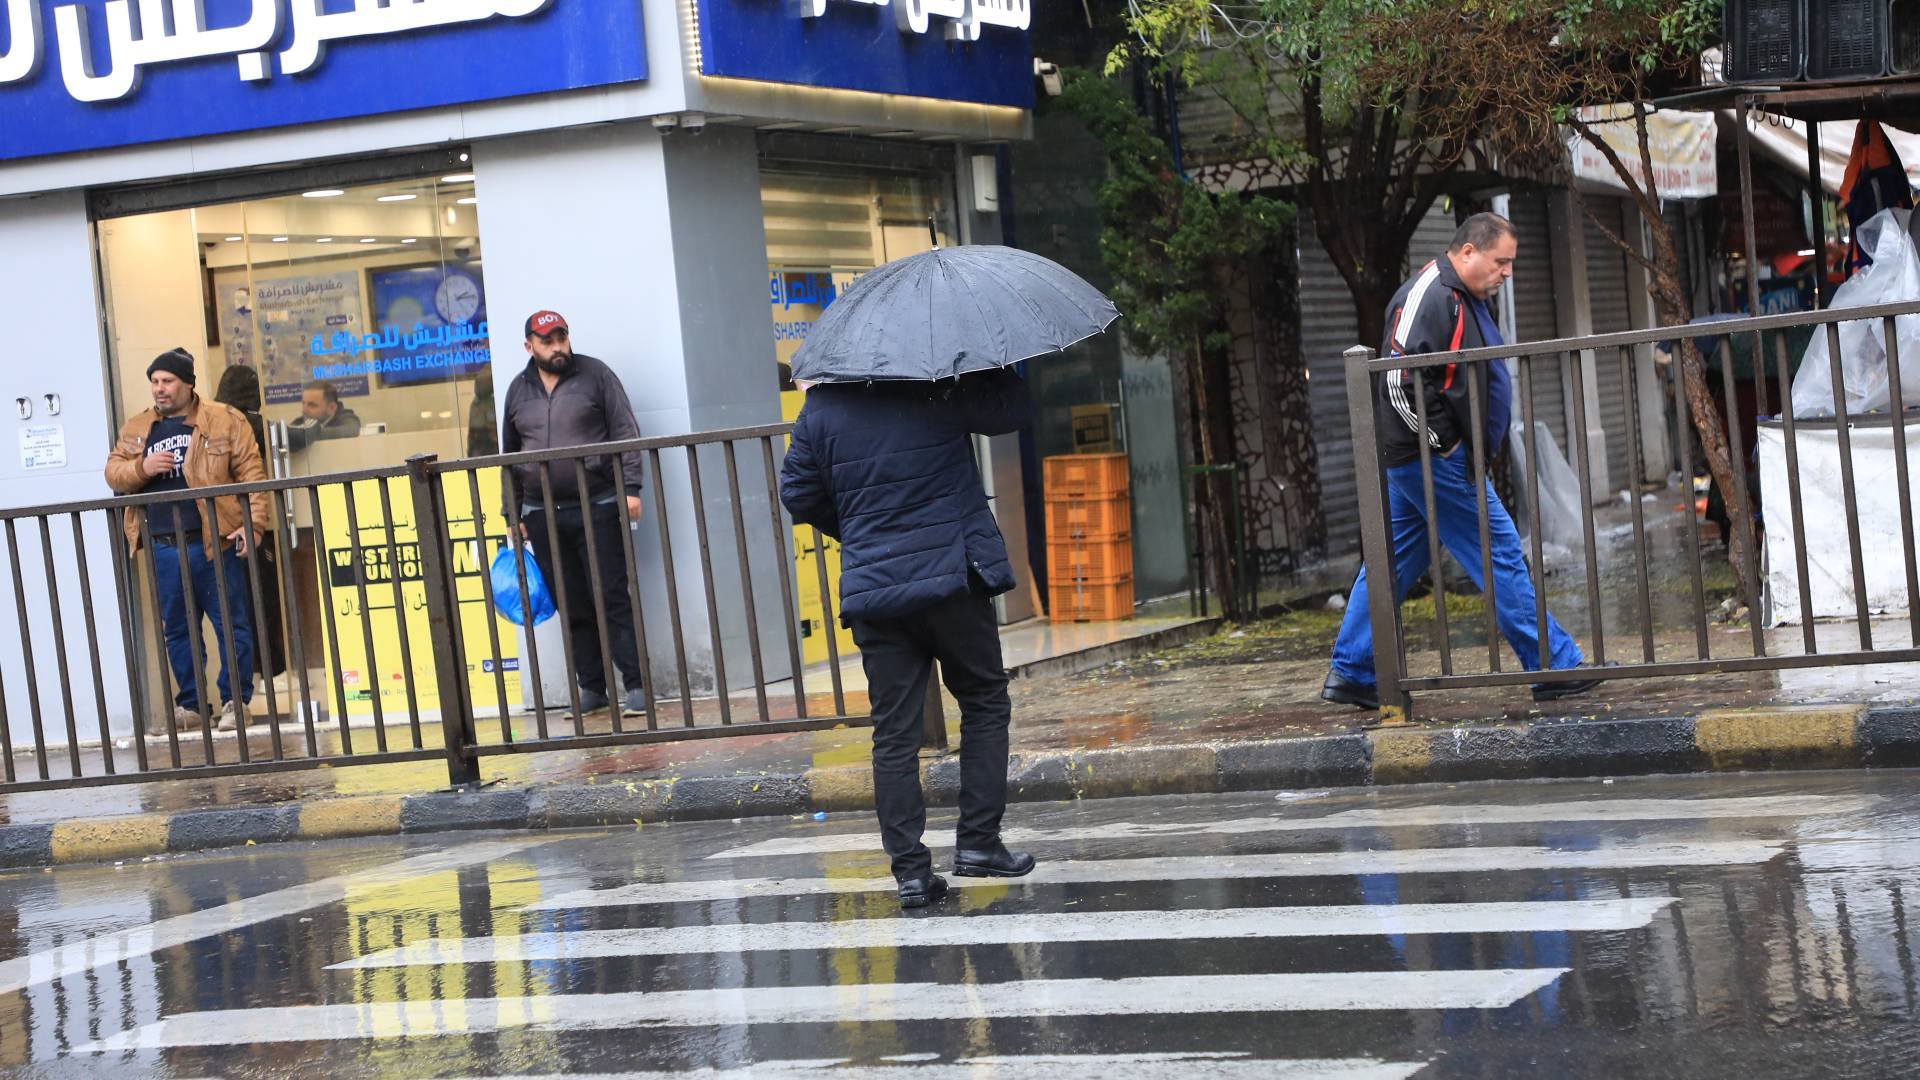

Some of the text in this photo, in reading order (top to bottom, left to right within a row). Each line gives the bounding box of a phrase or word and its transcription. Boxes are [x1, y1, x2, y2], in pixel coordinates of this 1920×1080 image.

[312, 349, 492, 380] MUSHARBASH EXCHANGE
[174, 448, 183, 463] &
[333, 544, 421, 567] WSTER
[365, 560, 424, 581] UNO
